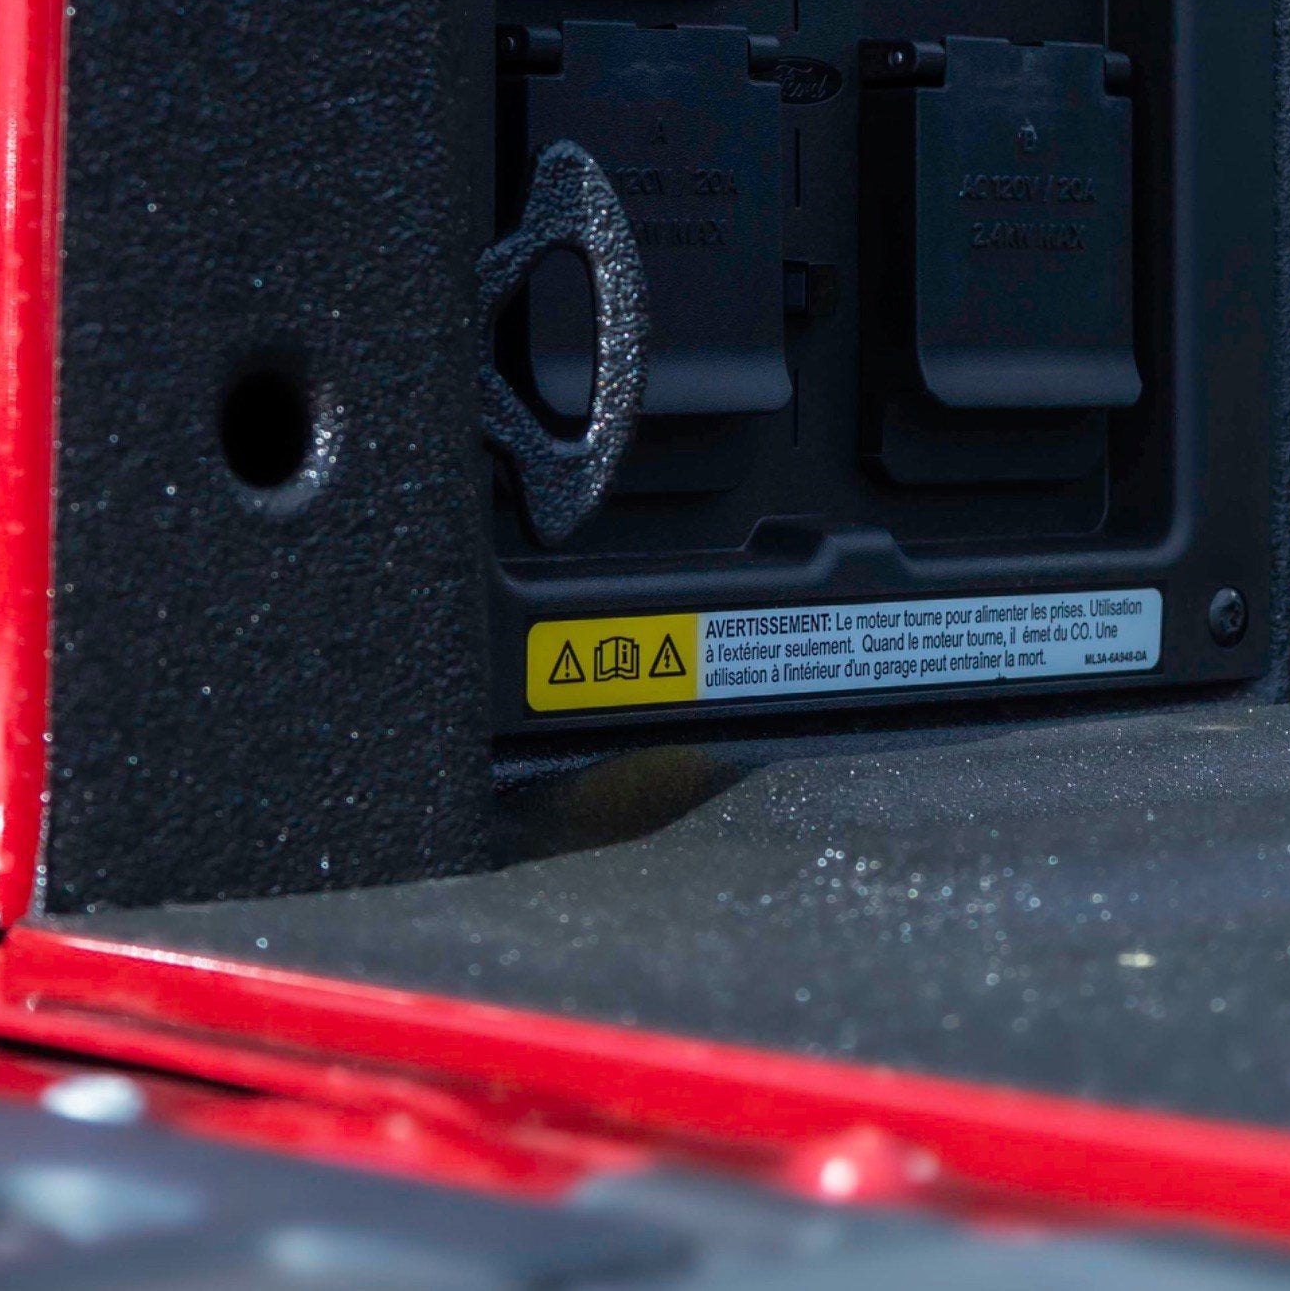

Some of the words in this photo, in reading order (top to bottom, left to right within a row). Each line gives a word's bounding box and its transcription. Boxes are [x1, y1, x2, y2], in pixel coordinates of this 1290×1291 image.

[705, 613, 832, 639] AVERTISSEMENT:
[836, 612, 852, 631] Le
[856, 611, 901, 630] moteur
[903, 609, 943, 627] tourne
[945, 609, 972, 629] pour
[975, 604, 1028, 624] alimenter
[1031, 602, 1047, 620] les
[1050, 601, 1087, 623] prises.
[1089, 597, 1142, 617] Utilisation
[706, 644, 714, 663] à
[718, 641, 782, 663] l'extérieur
[784, 636, 855, 658] seulement.
[862, 632, 905, 653] Quand
[908, 632, 919, 650] le
[922, 631, 964, 649] moteur
[966, 629, 1006, 647] tourne,
[1010, 626, 1016, 644] il
[1022, 625, 1051, 644] émet
[1054, 624, 1068, 641] du
[1070, 622, 1092, 640] CO.
[1096, 621, 1118, 639] Une
[705, 666, 767, 687] utilisation
[771, 664, 779, 683] à
[783, 661, 841, 682] l'intérieur
[844, 658, 870, 678] d'un
[874, 659, 917, 680] garage
[920, 655, 947, 677] peut
[950, 651, 1002, 671] entraîner
[1005, 649, 1014, 667] la
[1018, 649, 1047, 667] mort.
